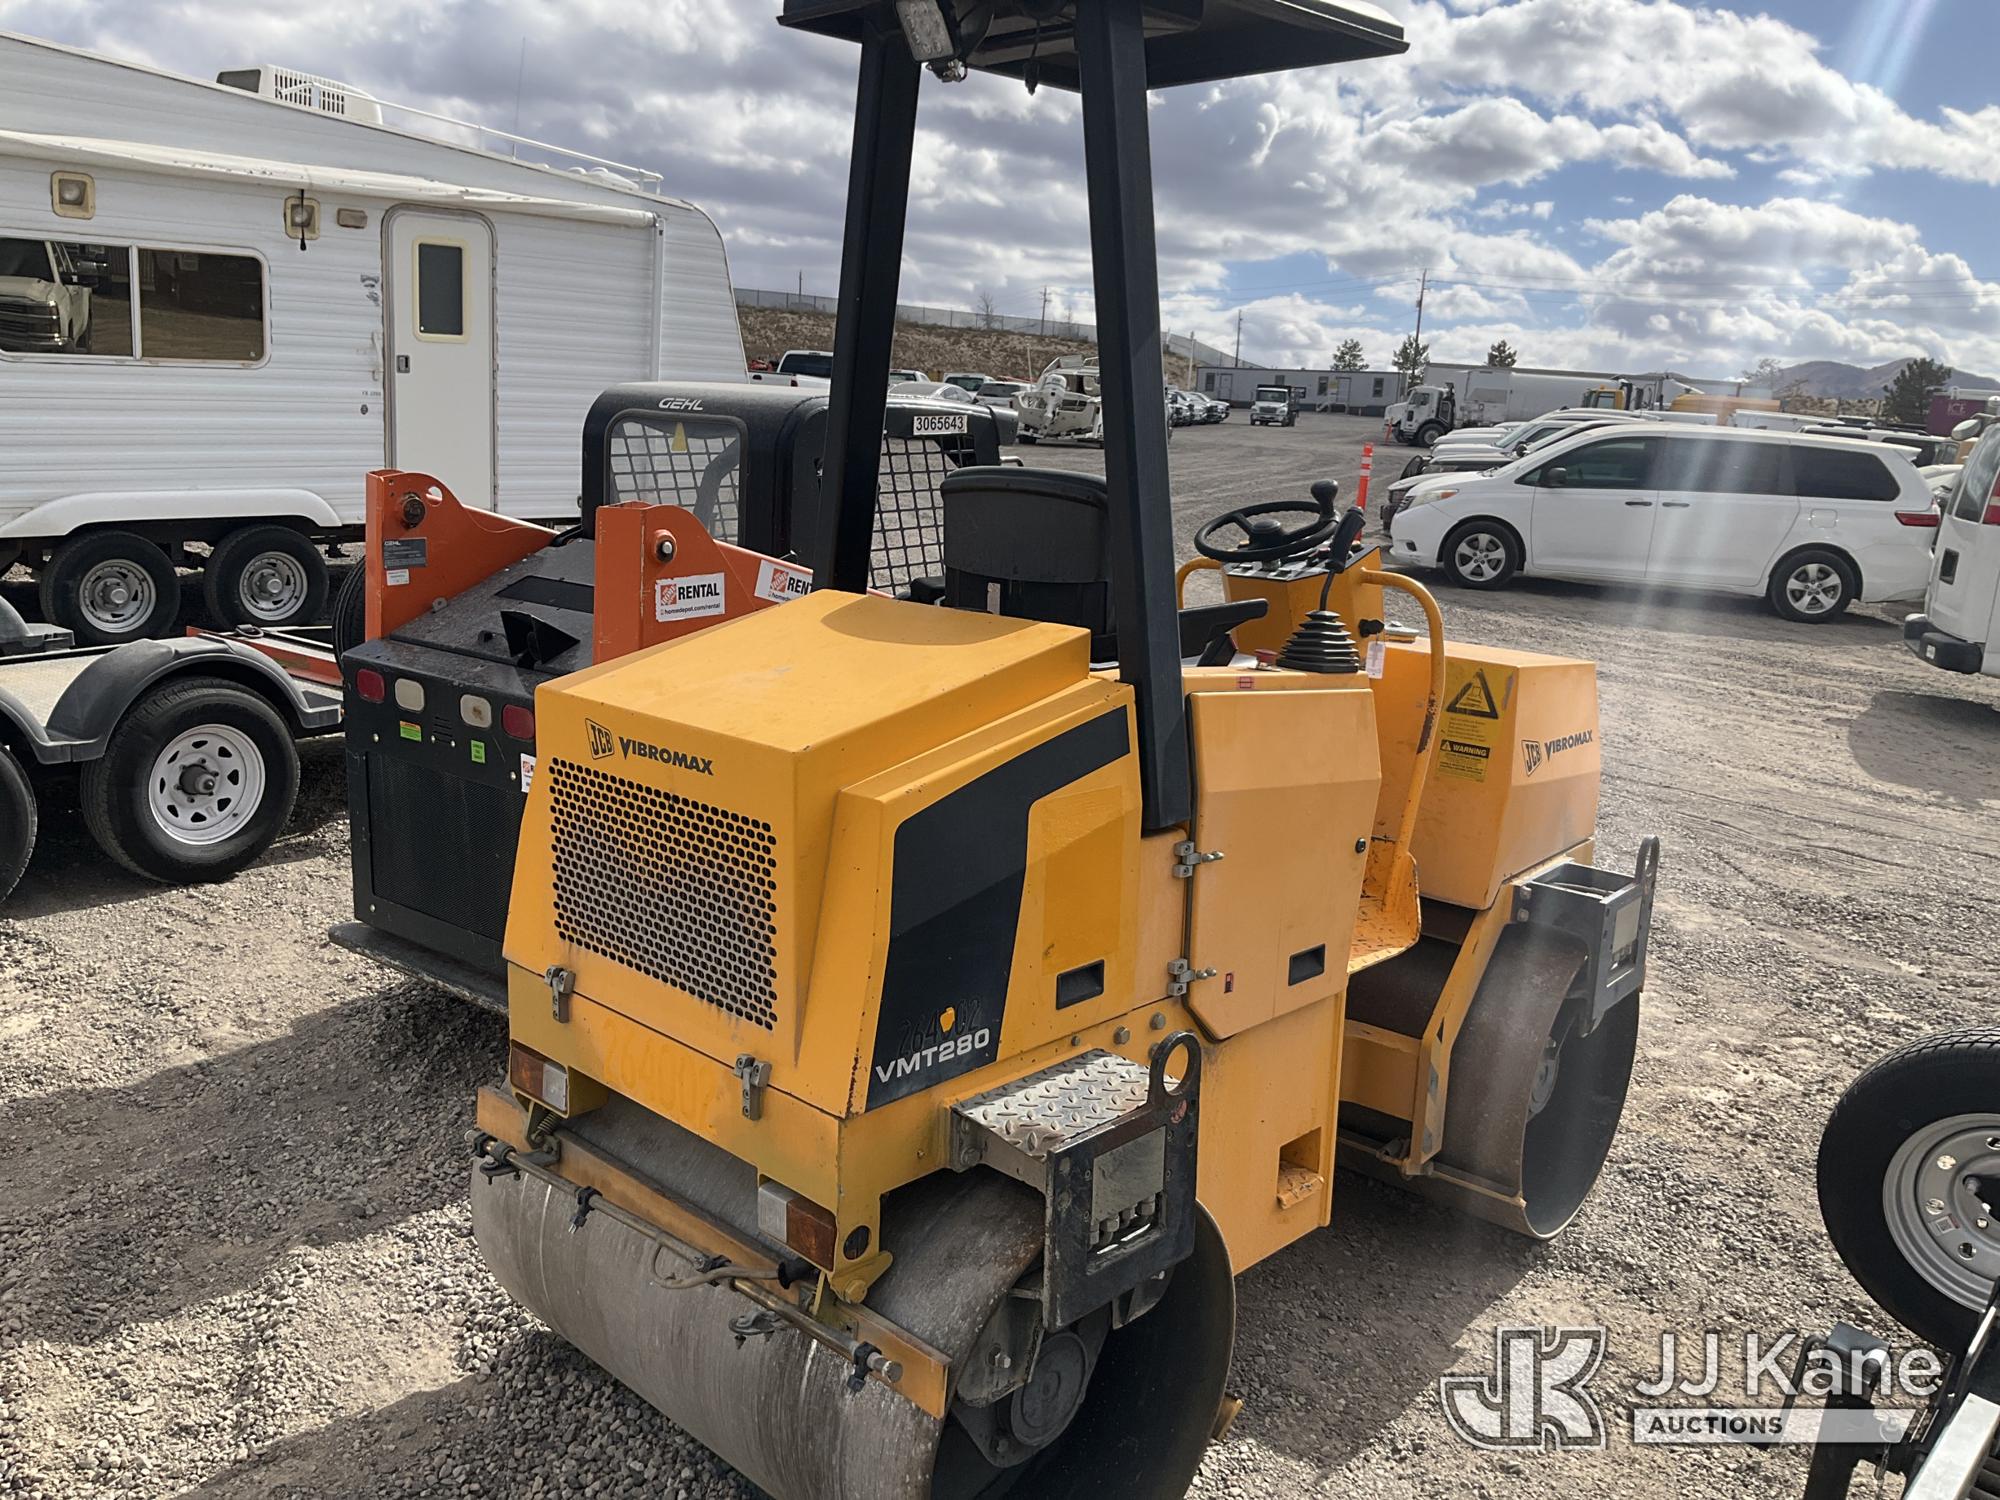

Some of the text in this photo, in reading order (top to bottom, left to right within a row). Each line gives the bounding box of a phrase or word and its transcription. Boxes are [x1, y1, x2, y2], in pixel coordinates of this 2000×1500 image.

[659, 397, 704, 411] GEHL
[916, 416, 964, 431] 3065643
[678, 583, 720, 600] RENTAL
[664, 602, 721, 616] homedepot.com/rental
[590, 723, 714, 777] JCB VIBROMAX
[1453, 743, 1487, 757] WARNING
[1525, 729, 1593, 772] JCB VIBROMAX
[875, 1028, 990, 1083] VMT280
